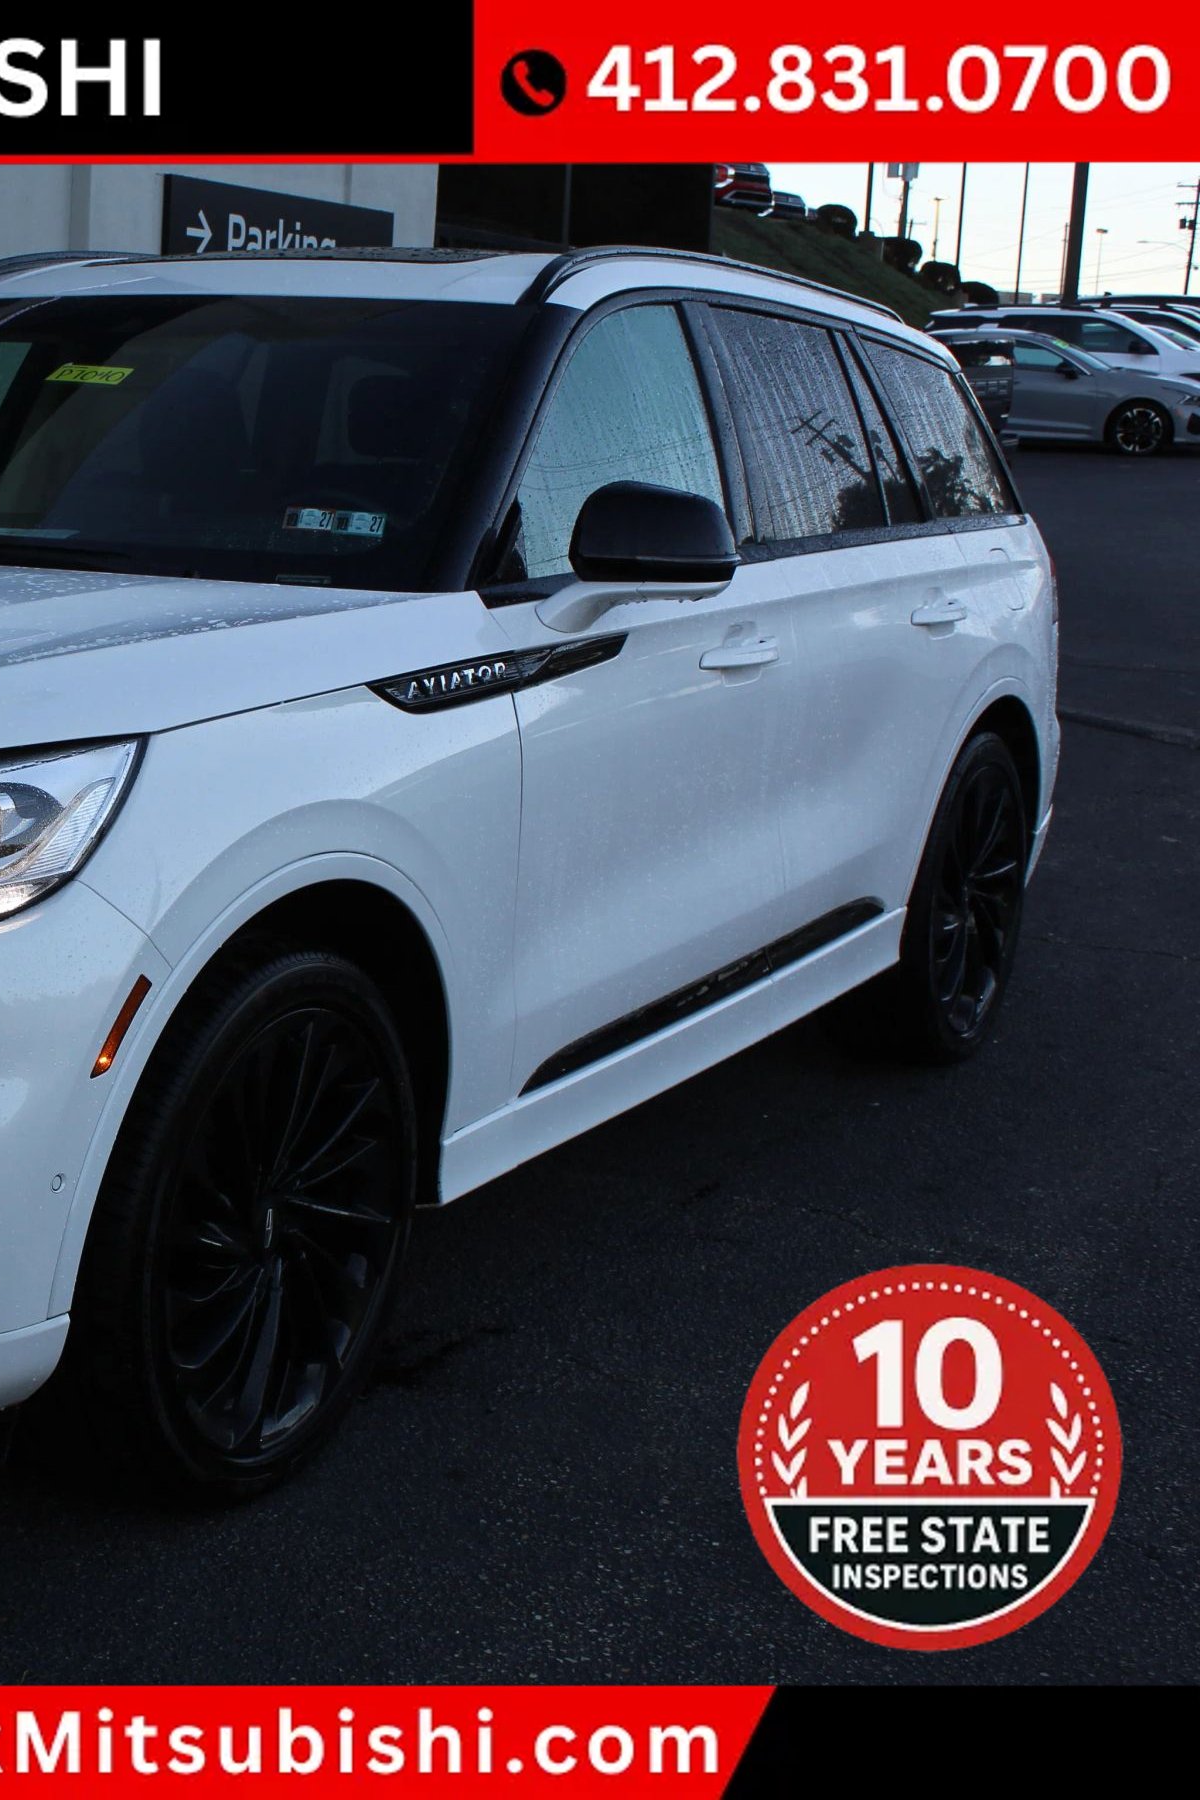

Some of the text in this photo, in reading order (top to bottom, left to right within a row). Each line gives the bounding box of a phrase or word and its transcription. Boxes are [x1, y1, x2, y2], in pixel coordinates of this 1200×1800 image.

[319, 511, 333, 529] 27
[368, 516, 384, 533] 27
[406, 662, 508, 699] AVIATOR
